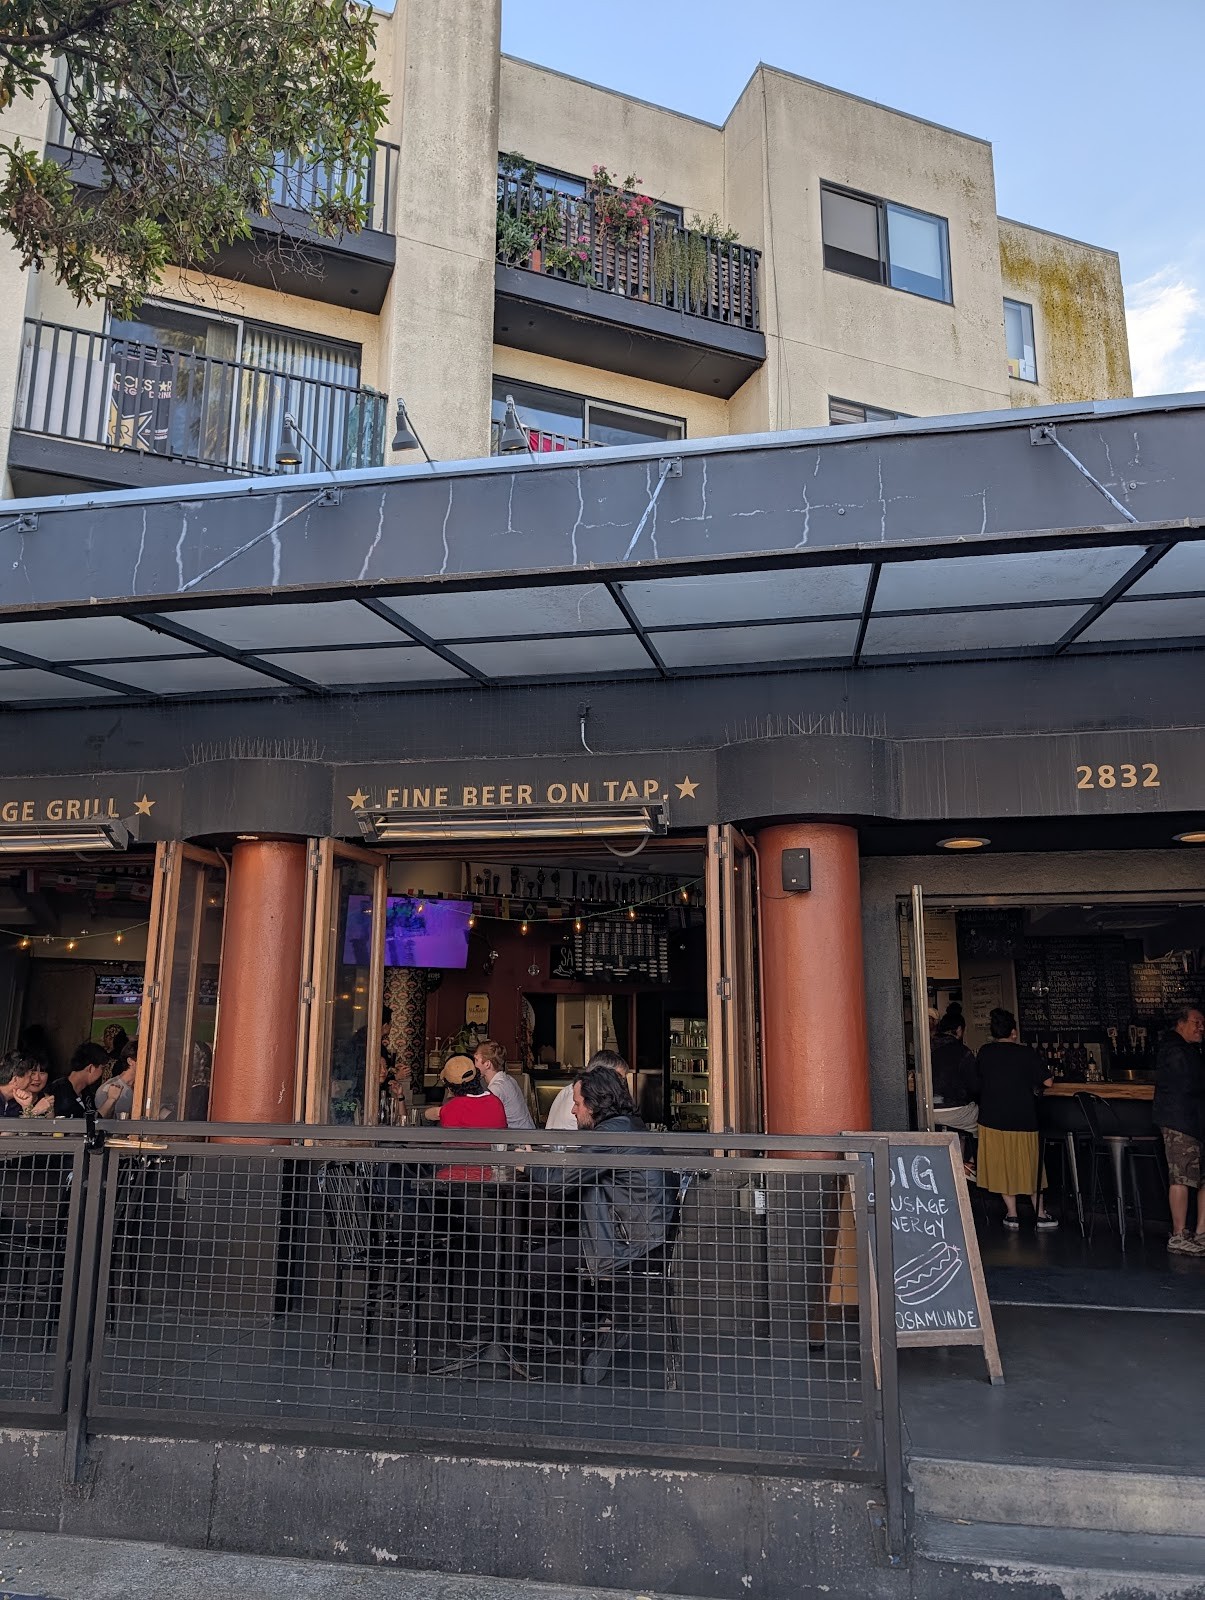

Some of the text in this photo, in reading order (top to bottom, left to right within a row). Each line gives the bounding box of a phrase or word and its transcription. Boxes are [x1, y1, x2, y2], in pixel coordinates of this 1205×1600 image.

[1076, 763, 1161, 789] 2832
[386, 779, 660, 808] FINE BEER ON TAP
[889, 1155, 939, 1195] IG
[890, 1195, 949, 1216] USAGE
[891, 1216, 946, 1240] NERGY
[895, 1308, 977, 1330] OSAMUNDE
